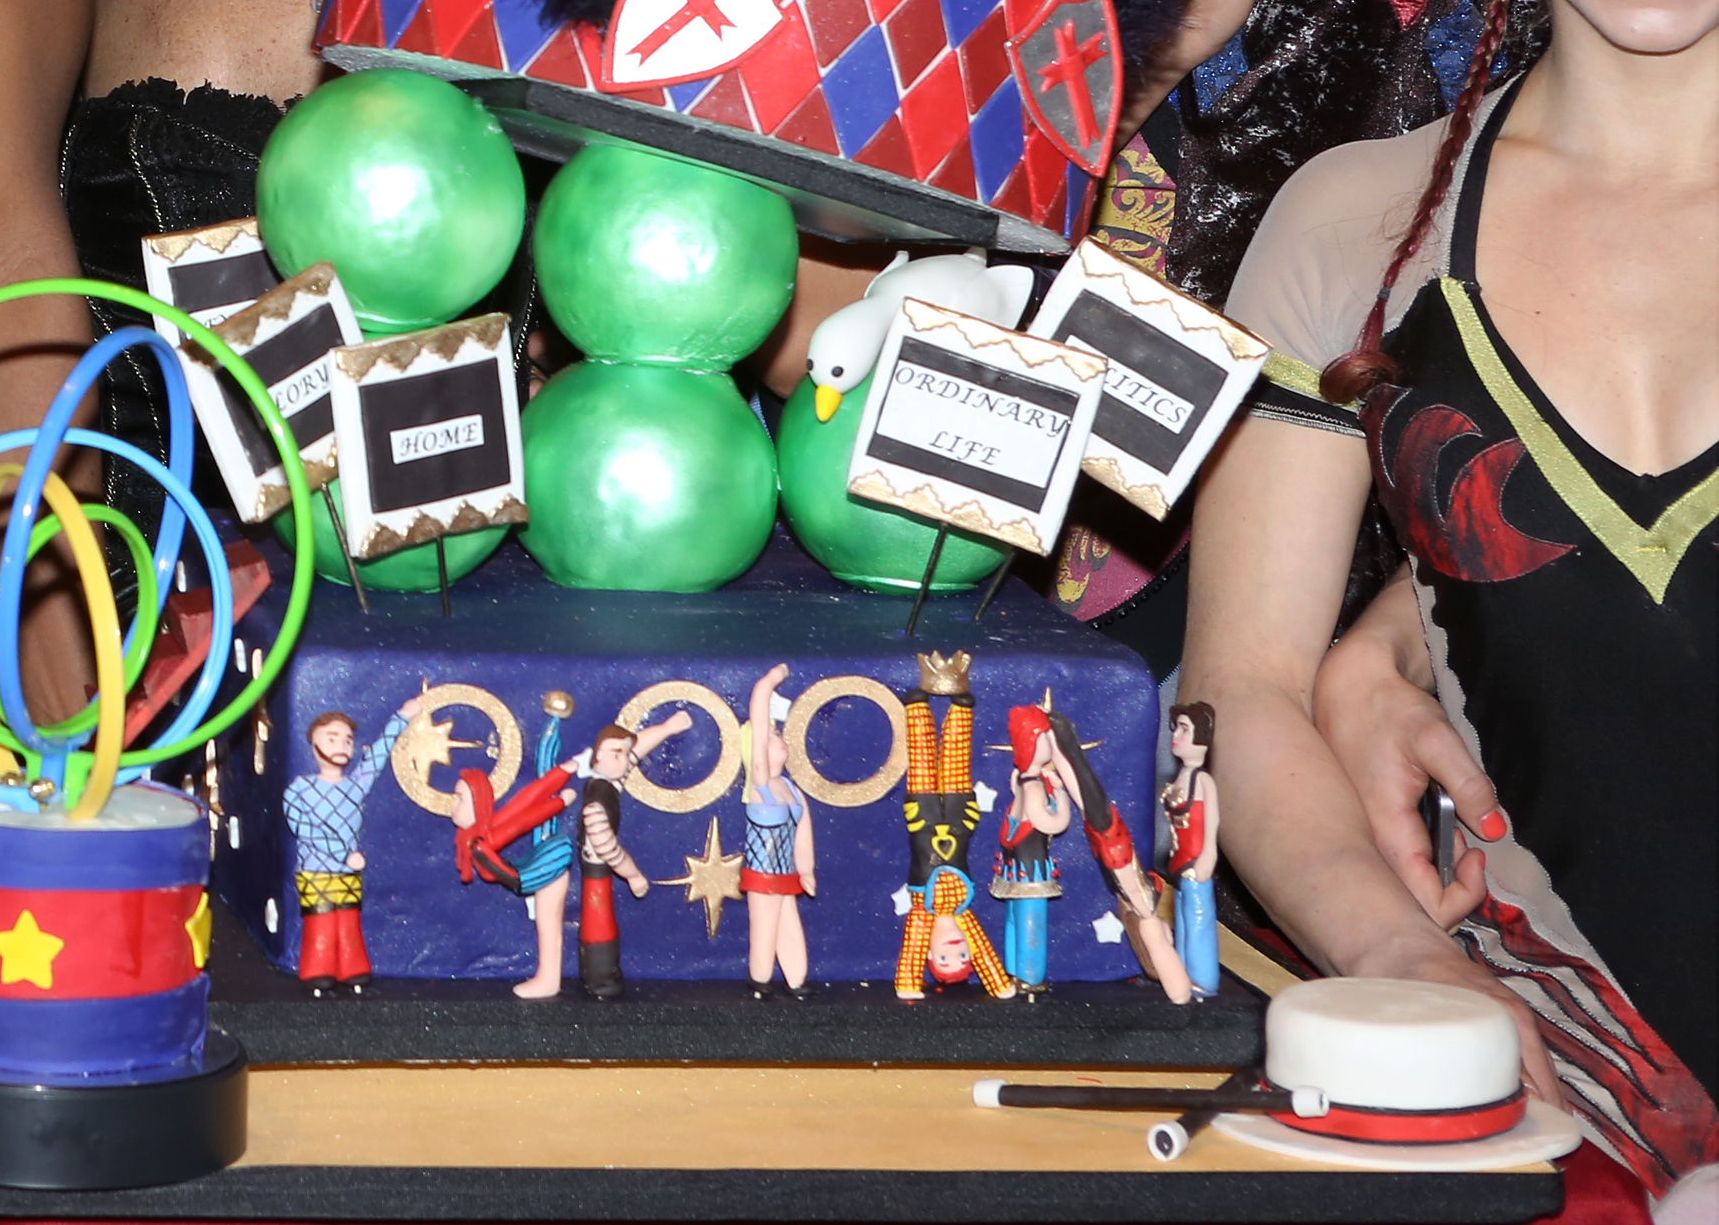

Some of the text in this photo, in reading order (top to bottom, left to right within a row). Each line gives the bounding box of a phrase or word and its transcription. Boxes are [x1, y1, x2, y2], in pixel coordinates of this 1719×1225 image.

[895, 367, 1069, 437] ORDINARY
[400, 422, 477, 457] HOME
[929, 431, 1001, 465] LIFE
